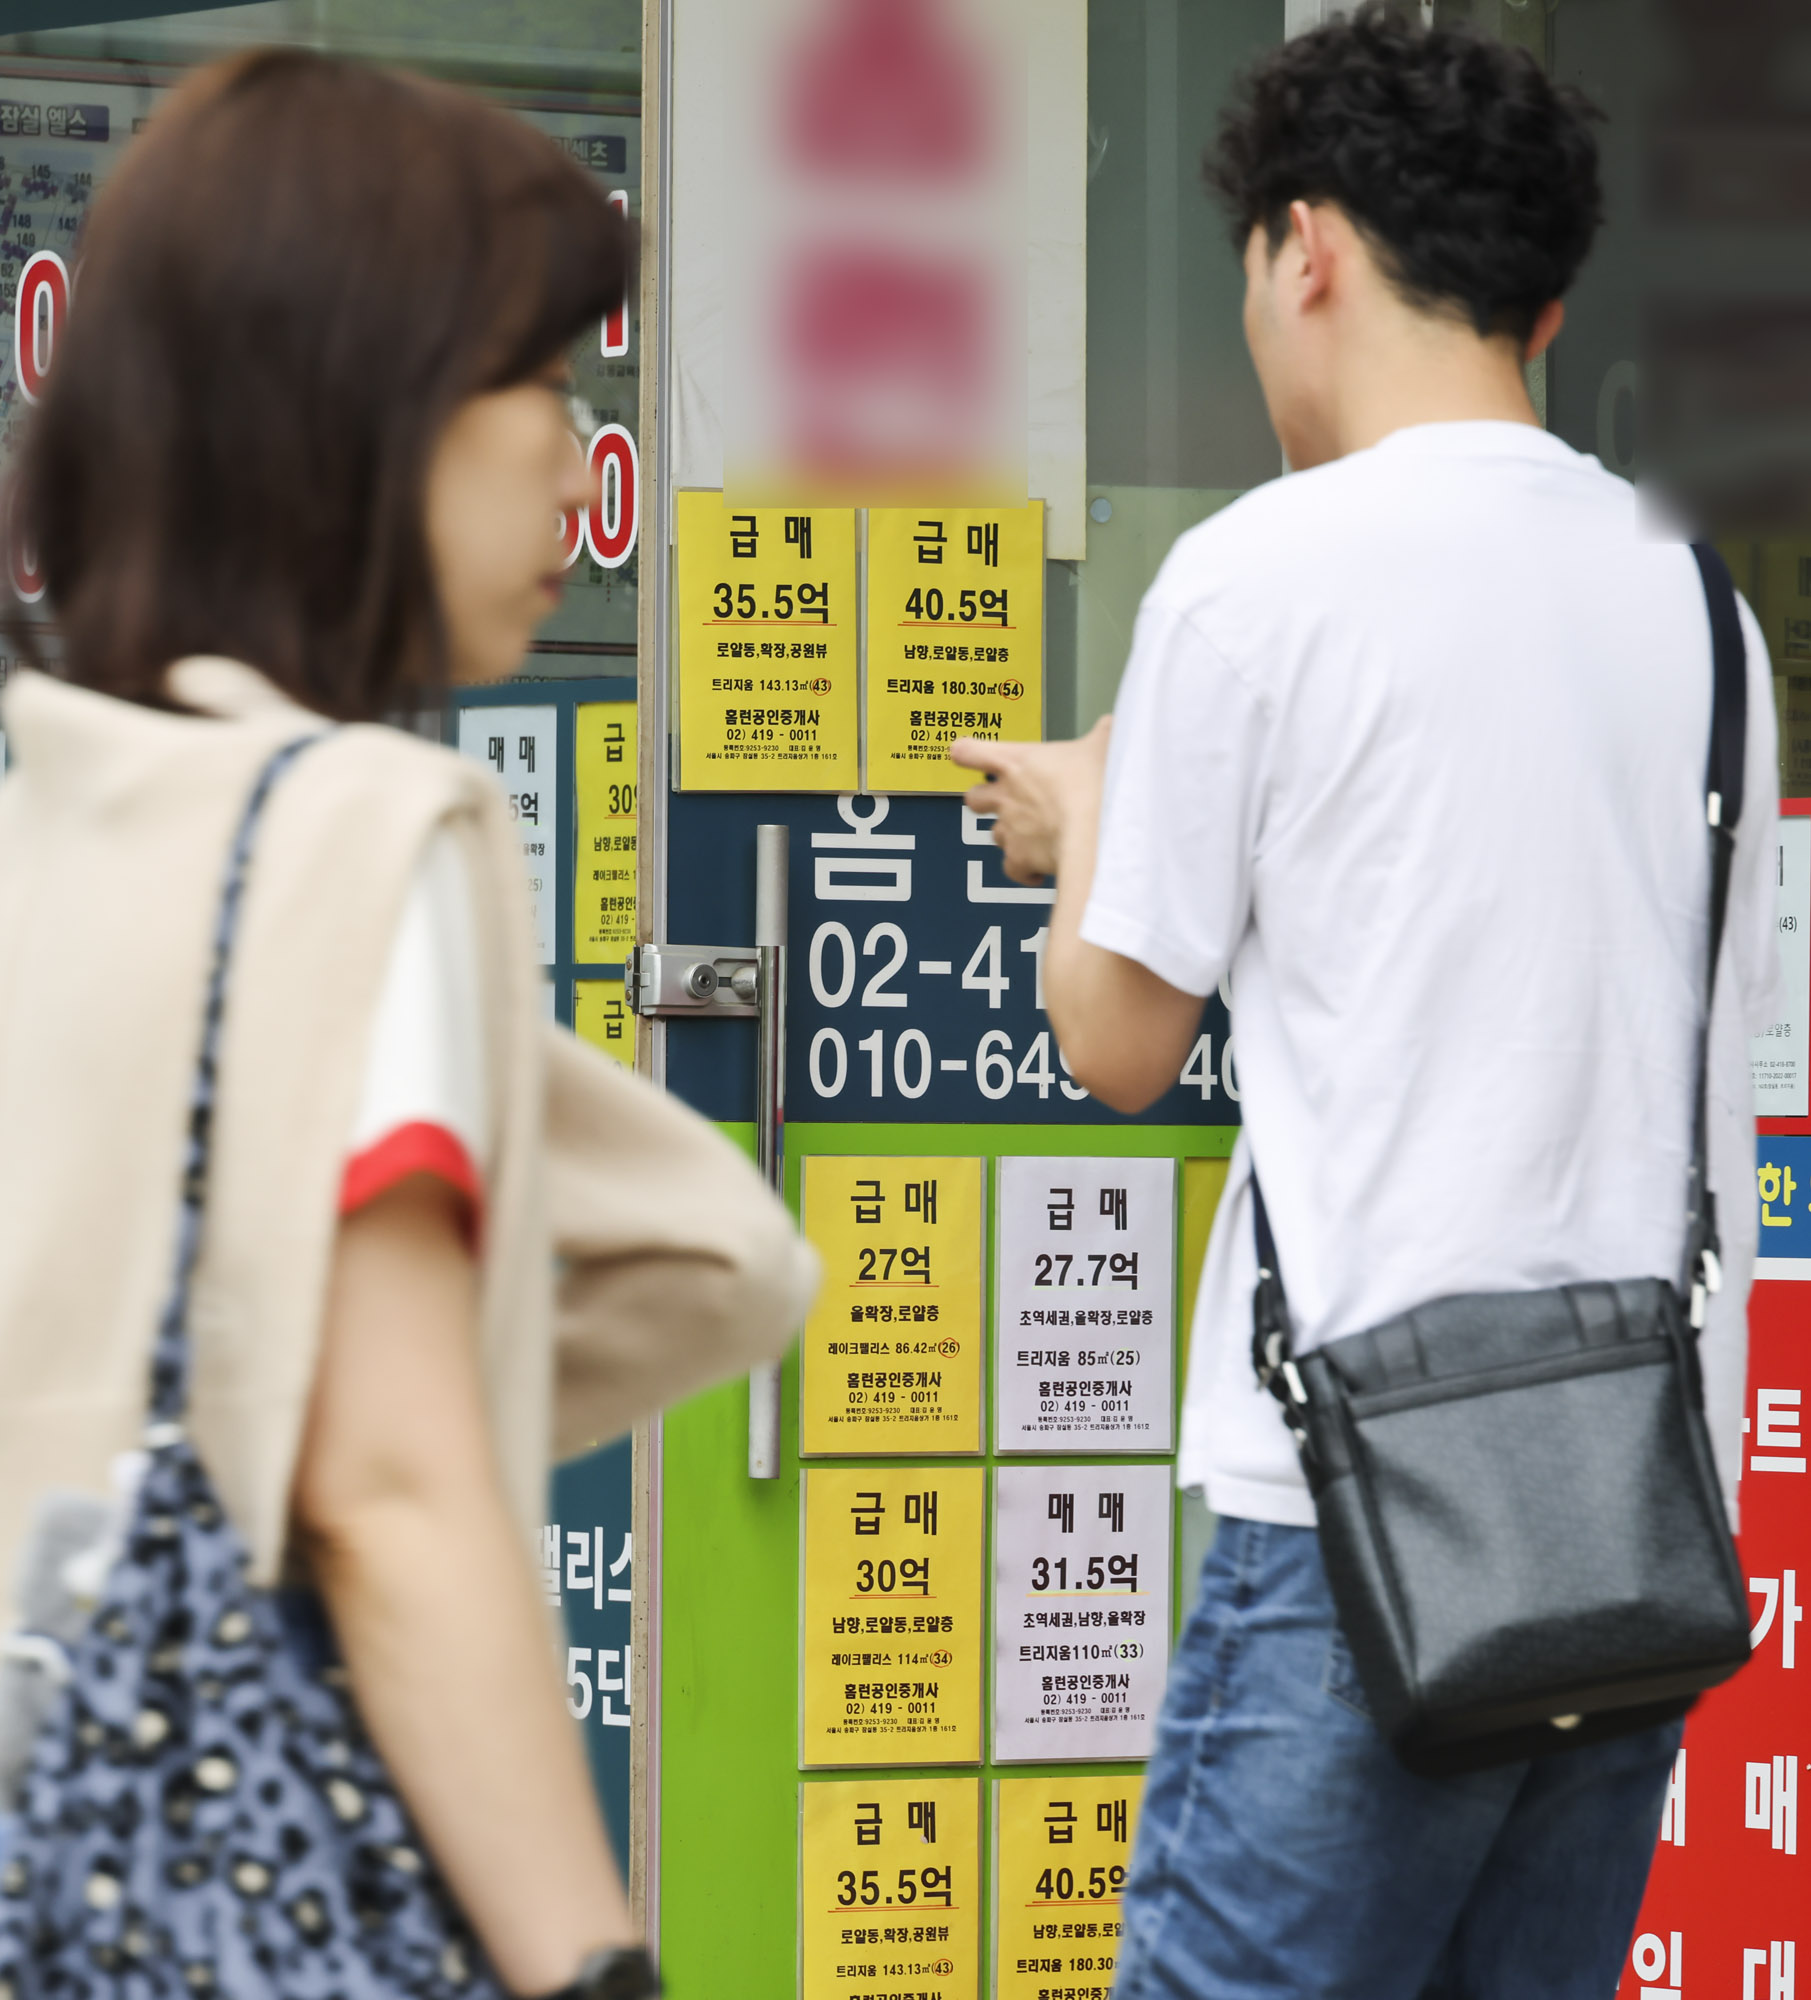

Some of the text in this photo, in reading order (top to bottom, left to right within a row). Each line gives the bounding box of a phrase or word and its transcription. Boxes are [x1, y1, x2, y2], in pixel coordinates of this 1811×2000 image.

[1, 105, 87, 136] 잠실 엘스
[32, 164, 51, 179] 145
[13, 214, 31, 229] 148
[730, 516, 811, 558] 급 매
[913, 521, 998, 567] 급 매
[714, 583, 828, 624] 35.5억
[906, 588, 1008, 627] 40.5억
[717, 643, 827, 658] 로얄동,확장,공원뷰
[905, 645, 1008, 662] 남향,로얄동,로얄층
[712, 679, 753, 691] 트리지움
[887, 679, 934, 694] 트리지움
[725, 709, 820, 726] 홈런공인중개사
[910, 711, 1002, 728] 홈런공인중개사
[604, 723, 625, 762] 급
[727, 729, 816, 740] 02) 419 0011
[911, 730, 930, 741] 02)
[936, 730, 957, 741] 419
[489, 736, 535, 772] 매 매
[609, 785, 637, 814] 30
[811, 793, 915, 901] 홈
[604, 1001, 624, 1039] 급
[851, 1180, 936, 1224] 급 매
[1757, 1162, 1797, 1226] 한
[1047, 1189, 1127, 1230] 급 매
[859, 1246, 930, 1284] 27억
[1035, 1252, 1138, 1290] 27.7억
[851, 1305, 939, 1322] 올확장,로얄층
[829, 1343, 889, 1354] 레이크팰리스
[1017, 1351, 1070, 1366] 트리지움
[847, 1372, 941, 1388] 홈런공인중개사
[1039, 1380, 1132, 1396] 홈런공인중개사
[849, 1391, 937, 1403] 02) 419 0011
[1041, 1400, 1128, 1412] 02) 419 0011
[851, 1491, 937, 1535] 급 매
[1048, 1493, 1123, 1533] 매 매
[857, 1558, 929, 1595] 30억
[1032, 1554, 1138, 1592] 31.5억
[833, 1616, 953, 1634] 남향,로얄동,로얄층
[832, 1654, 891, 1665] 레이크팰리스
[845, 1683, 939, 1699] 홈런공인중개사
[1042, 1674, 1130, 1691] 홈런공인중개사
[846, 1702, 935, 1714] 02) 419 0011
[1043, 1693, 1126, 1705] 02) 419 0011
[1745, 1755, 1797, 1854] 매
[855, 1802, 936, 1845] 급 매
[1044, 1800, 1126, 1843] 급 매
[838, 1866, 951, 1906] 35.5억
[842, 1926, 949, 1944] 로얄동,확장,공원뷰
[837, 1965, 876, 1977] 트리지움
[1017, 1958, 1118, 1973] 트리지움 180.30
